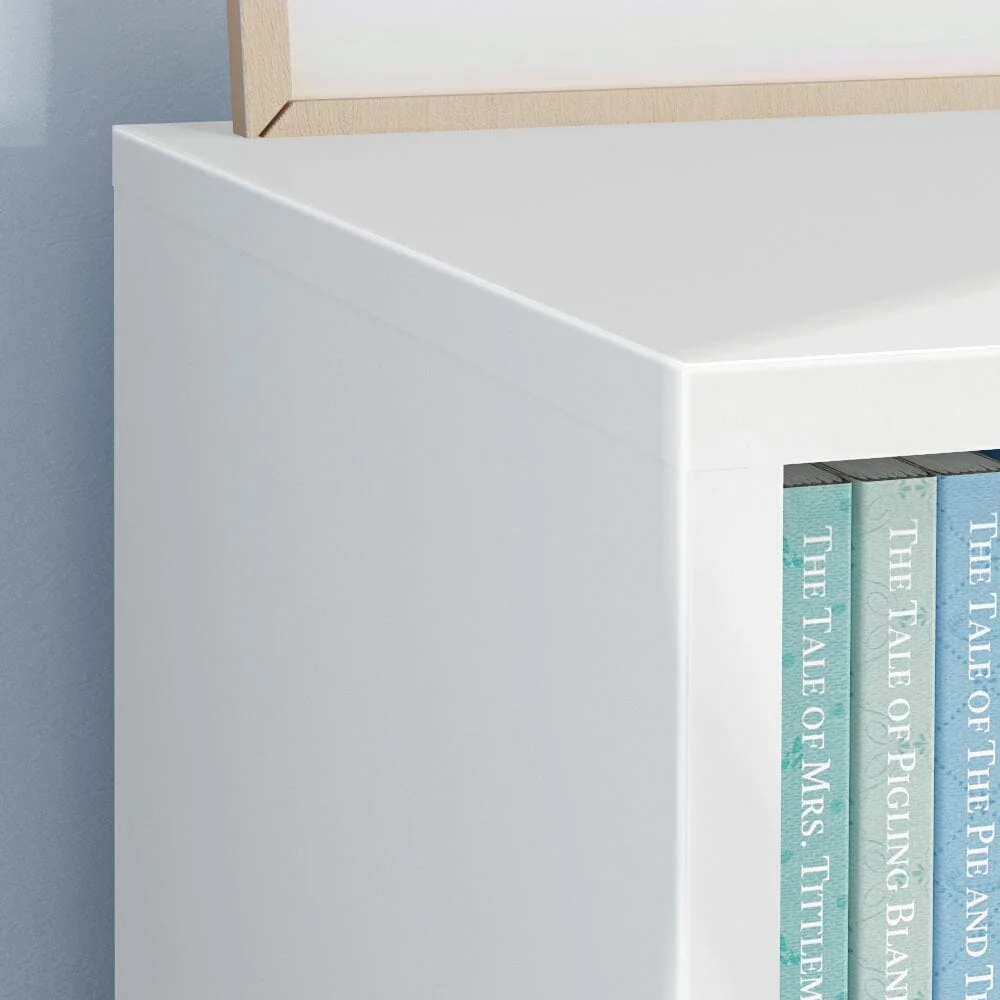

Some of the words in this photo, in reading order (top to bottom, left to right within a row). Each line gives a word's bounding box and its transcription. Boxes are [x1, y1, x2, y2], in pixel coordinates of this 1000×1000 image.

[803, 525, 832, 599] THE
[889, 518, 918, 592] THE
[968, 512, 998, 585] THE
[802, 607, 831, 696] TALE
[888, 599, 917, 688] TALE
[967, 592, 997, 681] TALE
[801, 706, 825, 750] OF
[887, 698, 911, 741] OF
[967, 690, 991, 733] OF
[801, 758, 831, 848] MRS.
[966, 739, 996, 813] THE
[886, 748, 916, 892] PIGLING
[966, 821, 995, 877] PIE
[965, 887, 989, 958] AND
